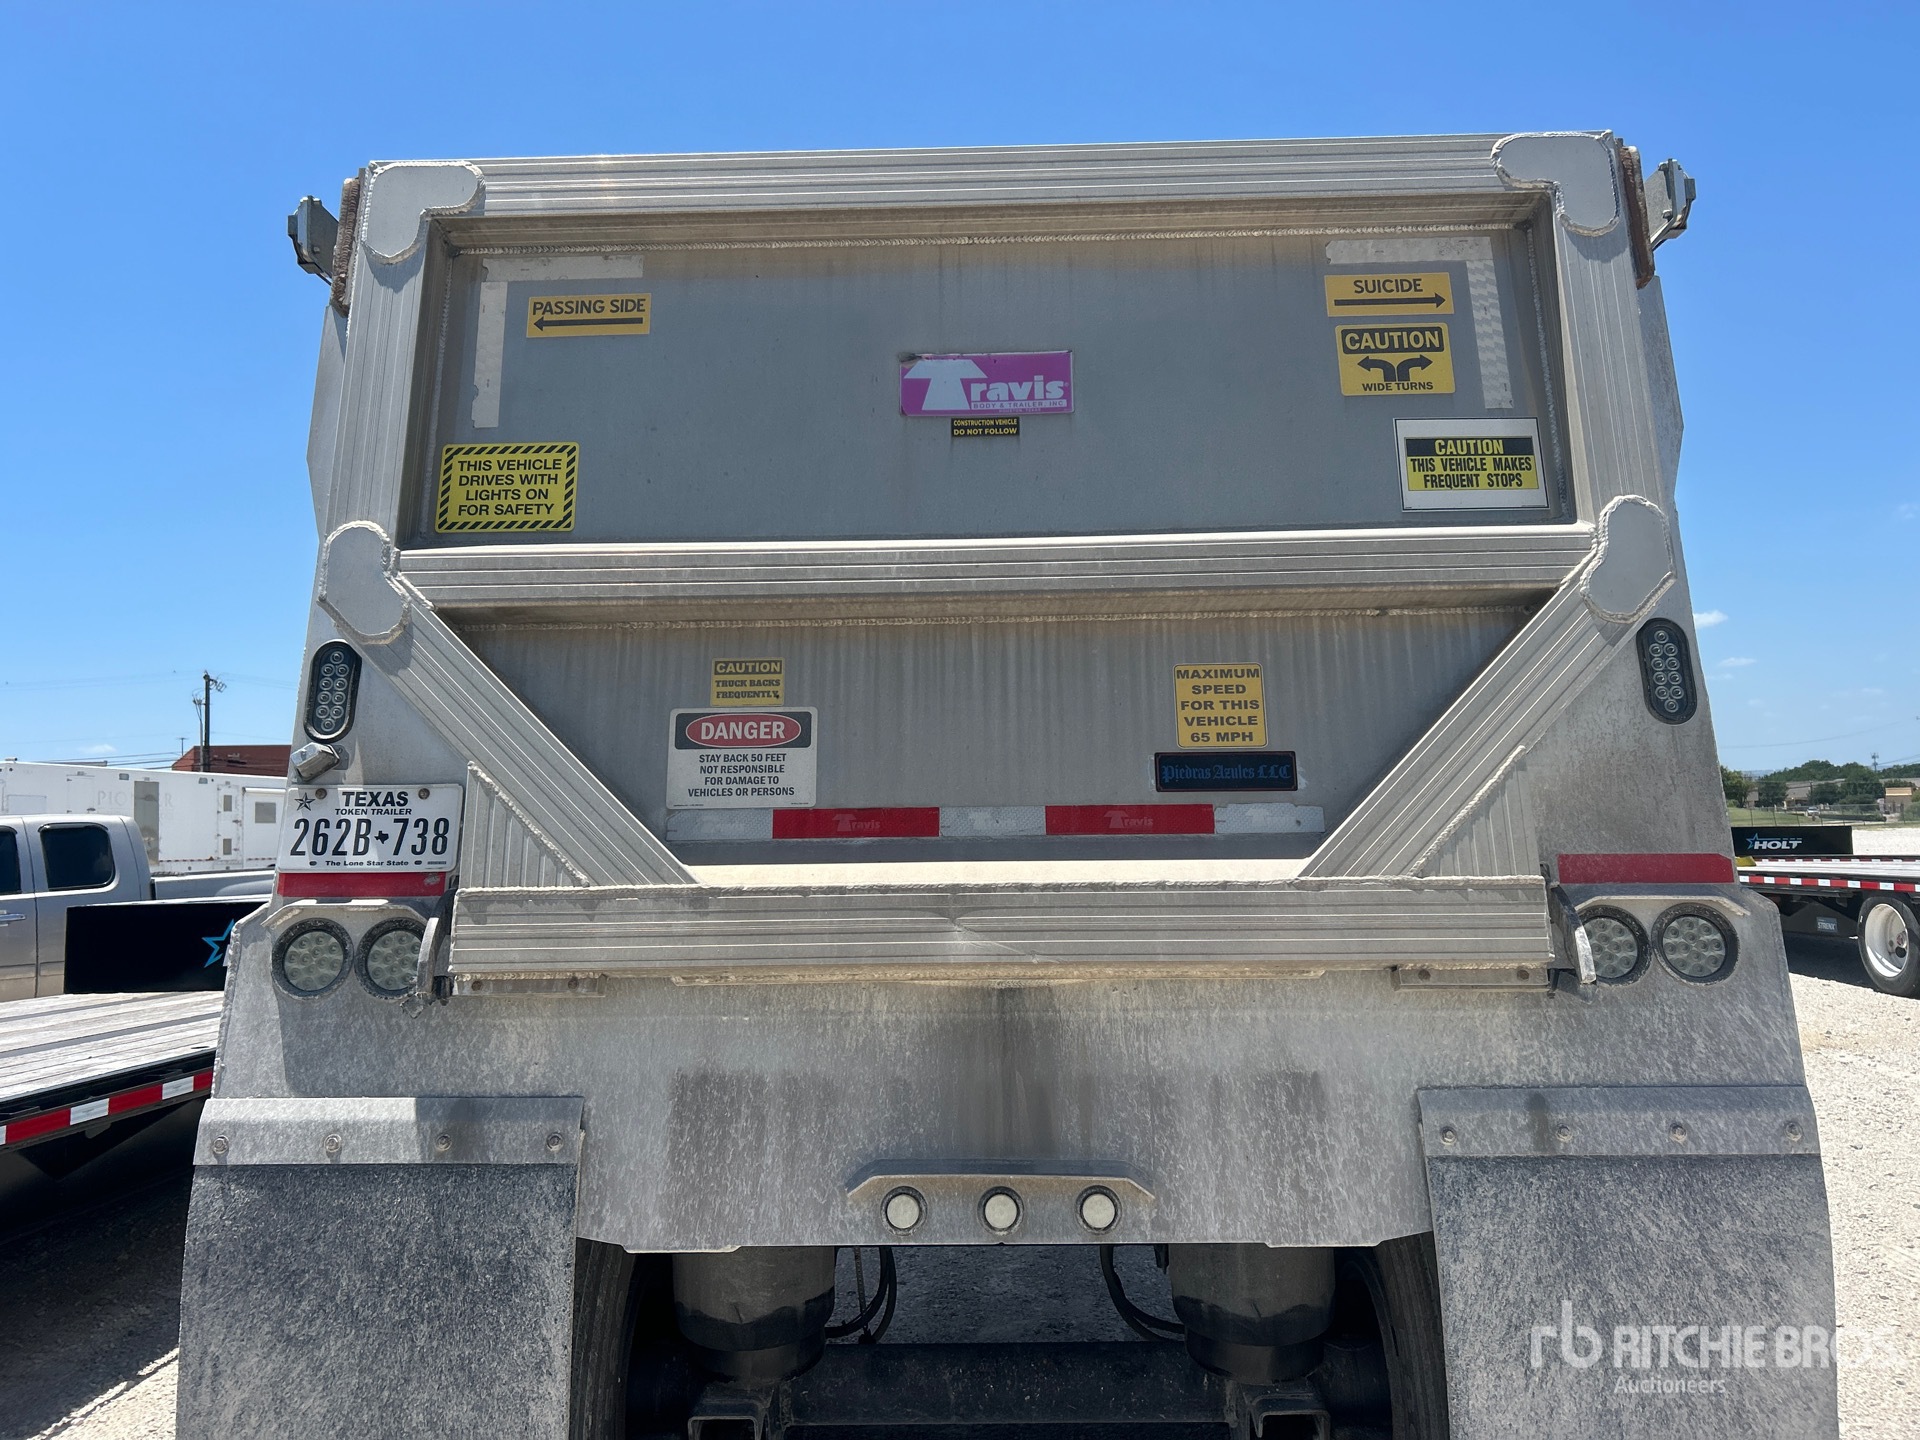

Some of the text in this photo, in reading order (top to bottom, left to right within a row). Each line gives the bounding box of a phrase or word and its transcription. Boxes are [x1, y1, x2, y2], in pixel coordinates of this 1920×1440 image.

[1353, 278, 1423, 294] SUICIDE
[532, 298, 646, 315] PASSING SIDE
[1345, 331, 1440, 350] CAUTION
[904, 359, 1064, 410] Travis
[1362, 382, 1434, 391] WIDE TURNS
[1434, 439, 1504, 455] CAUTION
[458, 458, 562, 471] THIS VEHICLE
[1410, 457, 1532, 472] THIS VEHICLE MAKES
[458, 474, 558, 486] DRIVES WITH
[1424, 473, 1523, 489] FREQUENT STOPS
[465, 488, 549, 500] LIGHTS ON
[458, 504, 554, 516] FOR SAFETY
[716, 662, 780, 673] CAUTION
[1176, 669, 1260, 679] MAXIMUM
[716, 690, 779, 699] FREQUENTLY
[1191, 684, 1246, 695] SPEED
[1181, 700, 1259, 710] FOR THIS
[1184, 716, 1258, 726] VEHICLE
[701, 722, 786, 740] DANGER
[1190, 732, 1253, 742] 65 MPH
[699, 754, 786, 763] STAY BACK 50 FEET
[700, 764, 785, 774] NOT RESPONSIBLE
[704, 776, 779, 785] FOR DAMAGE TO
[688, 787, 795, 797] VEHICLES OR PERSONS
[342, 791, 409, 807] TEXAS
[290, 818, 449, 856] 262B 738
[1753, 840, 1802, 850] HOLT
